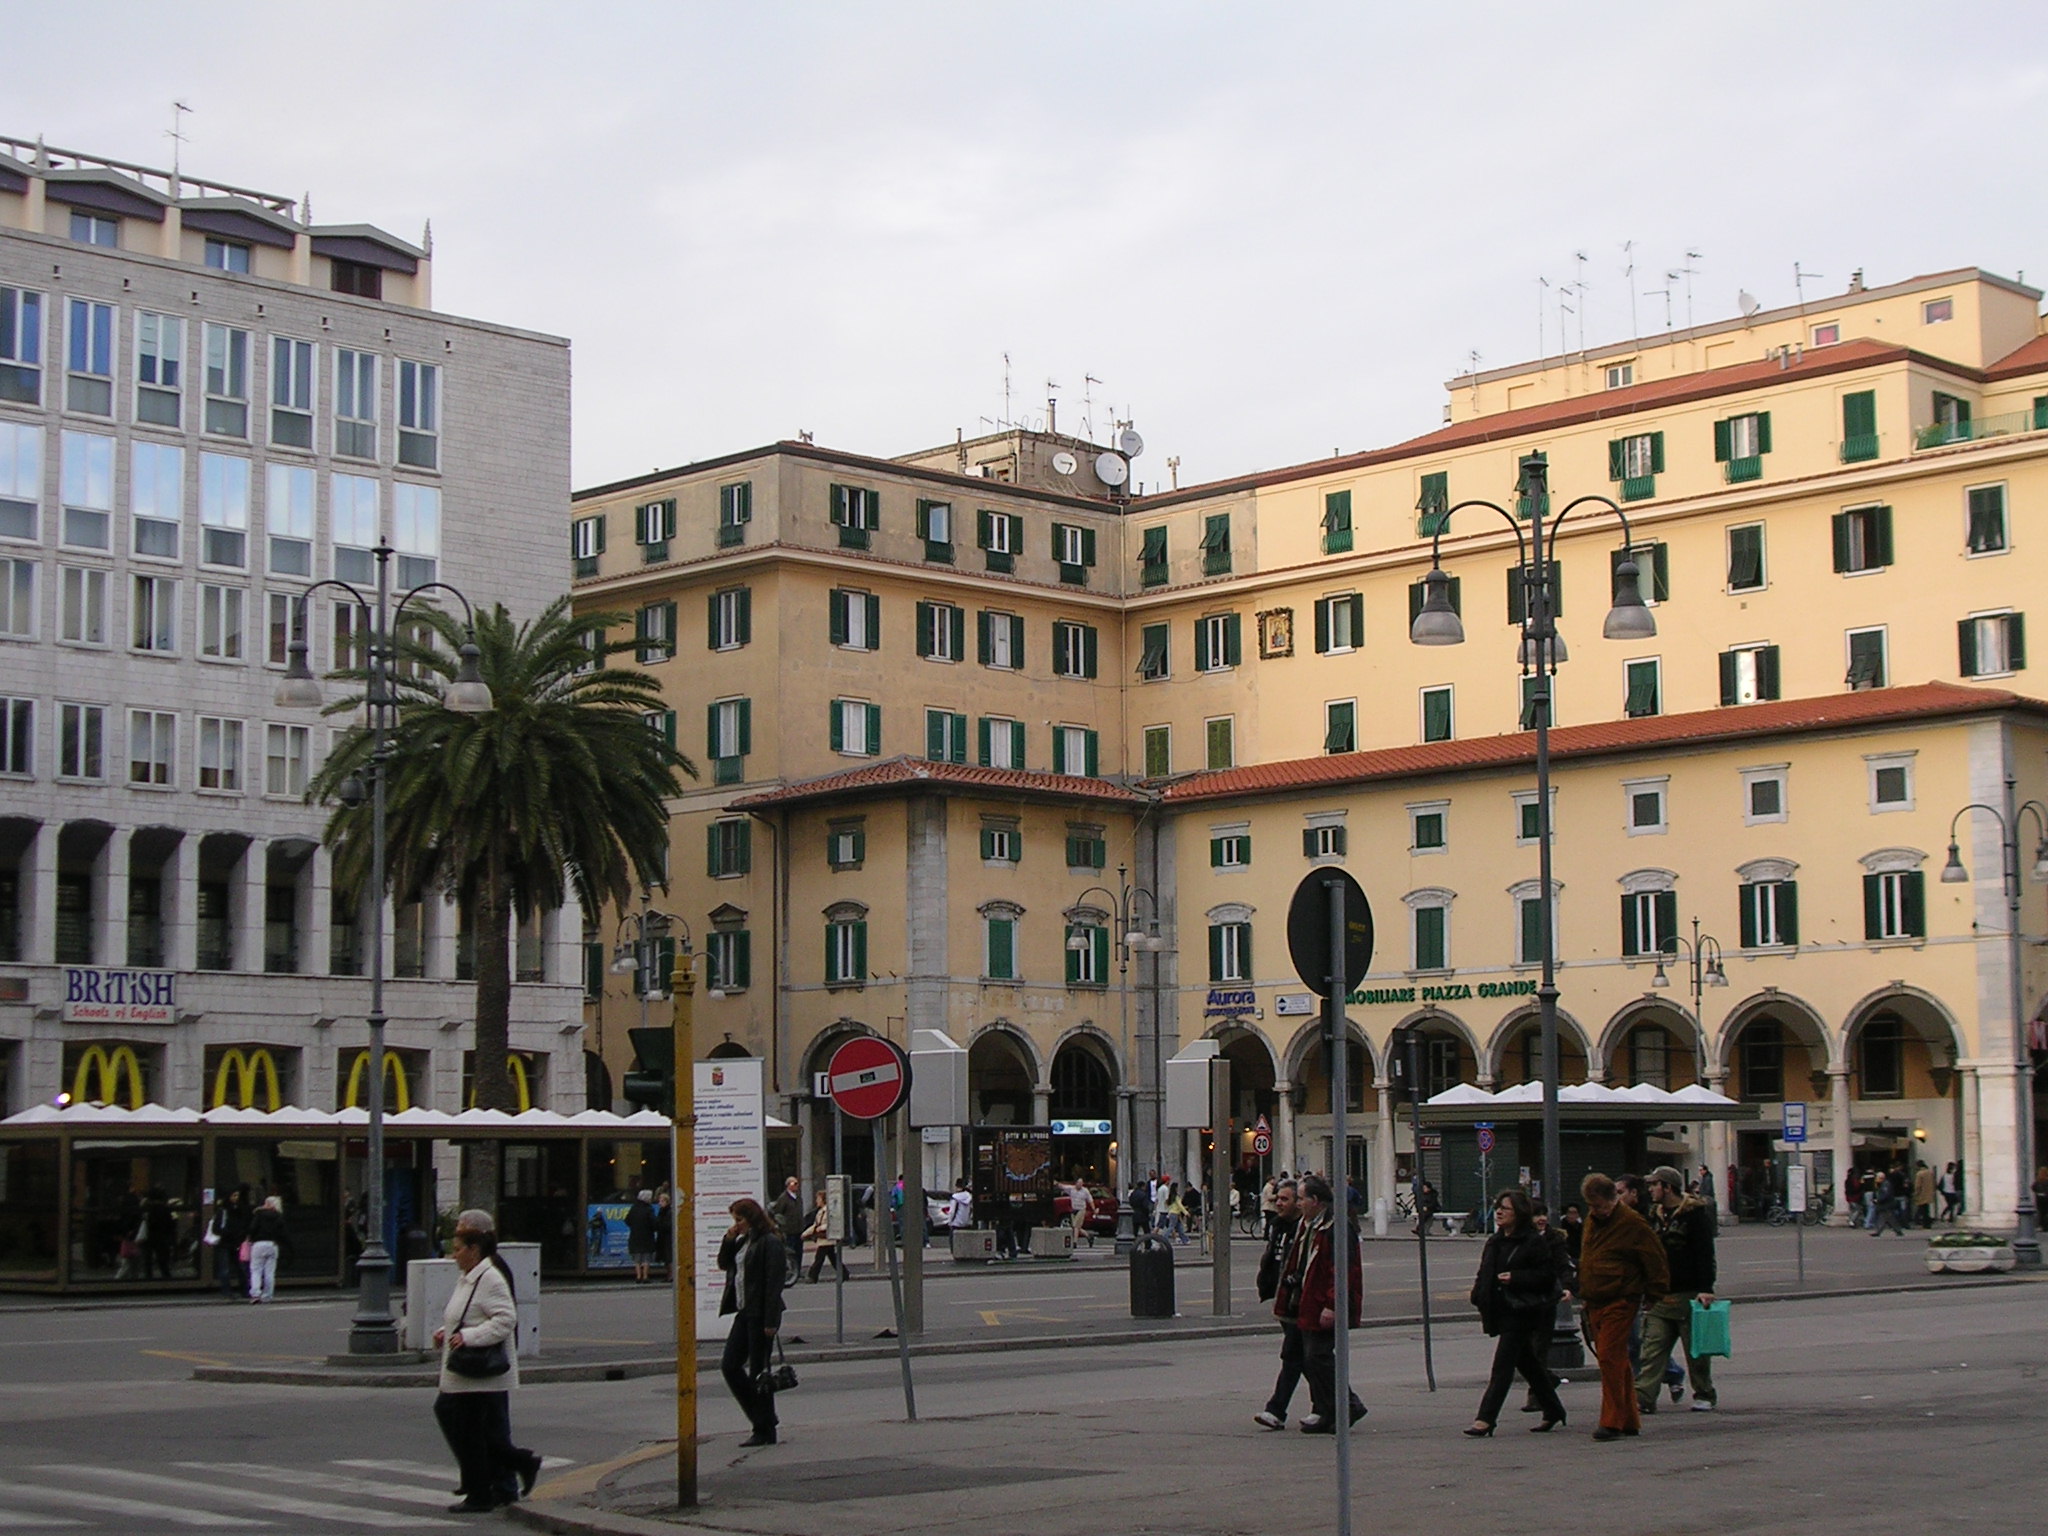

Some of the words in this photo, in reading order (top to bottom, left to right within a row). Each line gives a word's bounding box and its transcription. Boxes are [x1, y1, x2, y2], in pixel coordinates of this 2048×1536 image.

[1207, 989, 1255, 1005] Aurora
[1344, 987, 1415, 1005] MOBILIARE
[1422, 985, 1471, 1002] PIAZZA
[1478, 979, 1537, 998] GRANDE
[72, 1005, 109, 1018] Schools
[115, 1008, 126, 1021] of
[131, 1006, 168, 1022] English
[1257, 1138, 1268, 1149] 20
